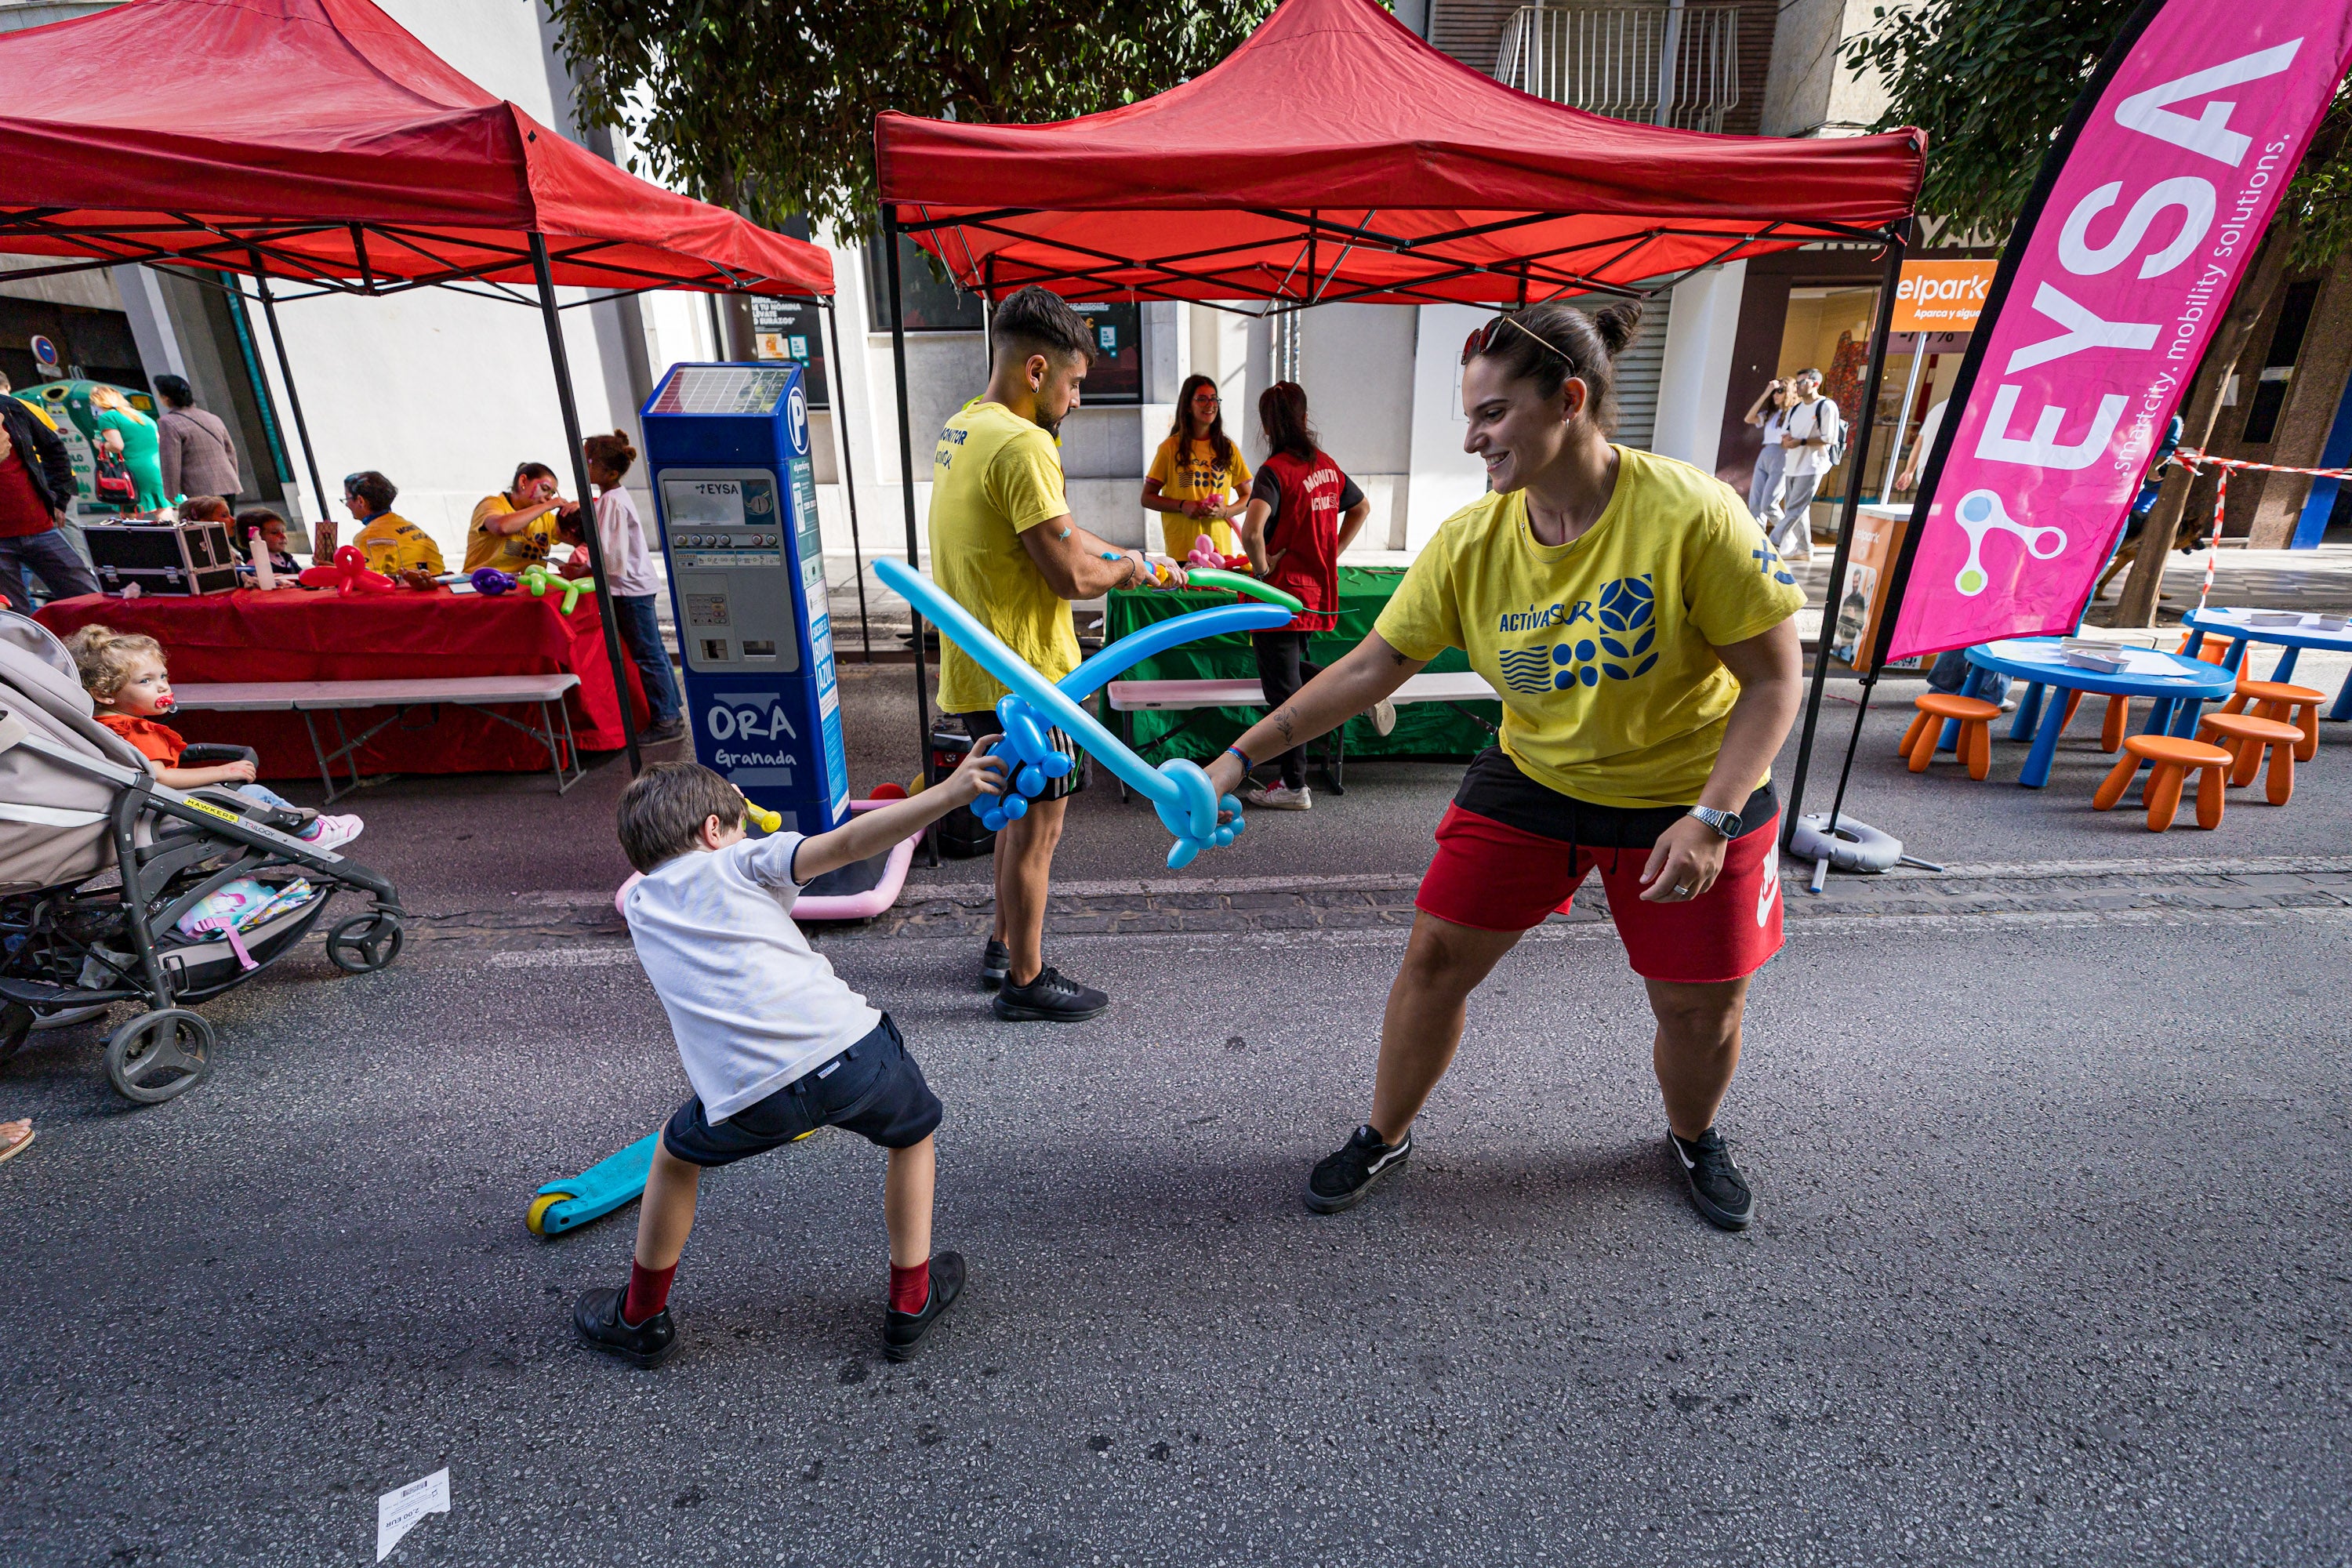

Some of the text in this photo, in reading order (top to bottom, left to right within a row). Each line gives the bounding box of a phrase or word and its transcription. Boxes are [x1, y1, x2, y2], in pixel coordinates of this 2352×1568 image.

[1974, 36, 2304, 470] EYSA
[2166, 263, 2227, 360] mobility
[2213, 134, 2290, 257] solutions.
[1896, 275, 1989, 306] elpark
[1914, 308, 1947, 320] Aparca
[1948, 310, 1956, 320] y
[791, 396, 804, 446] P
[707, 484, 739, 495] EYSA
[1302, 469, 1338, 493] MONIT
[814, 632, 831, 666] BONO
[818, 659, 834, 692] AZUL
[707, 706, 797, 740] ORA
[715, 749, 797, 768] Granada
[187, 799, 236, 821] HAWKERS
[245, 820, 275, 837] TRILOGY
[386, 1517, 402, 1528] EUR
